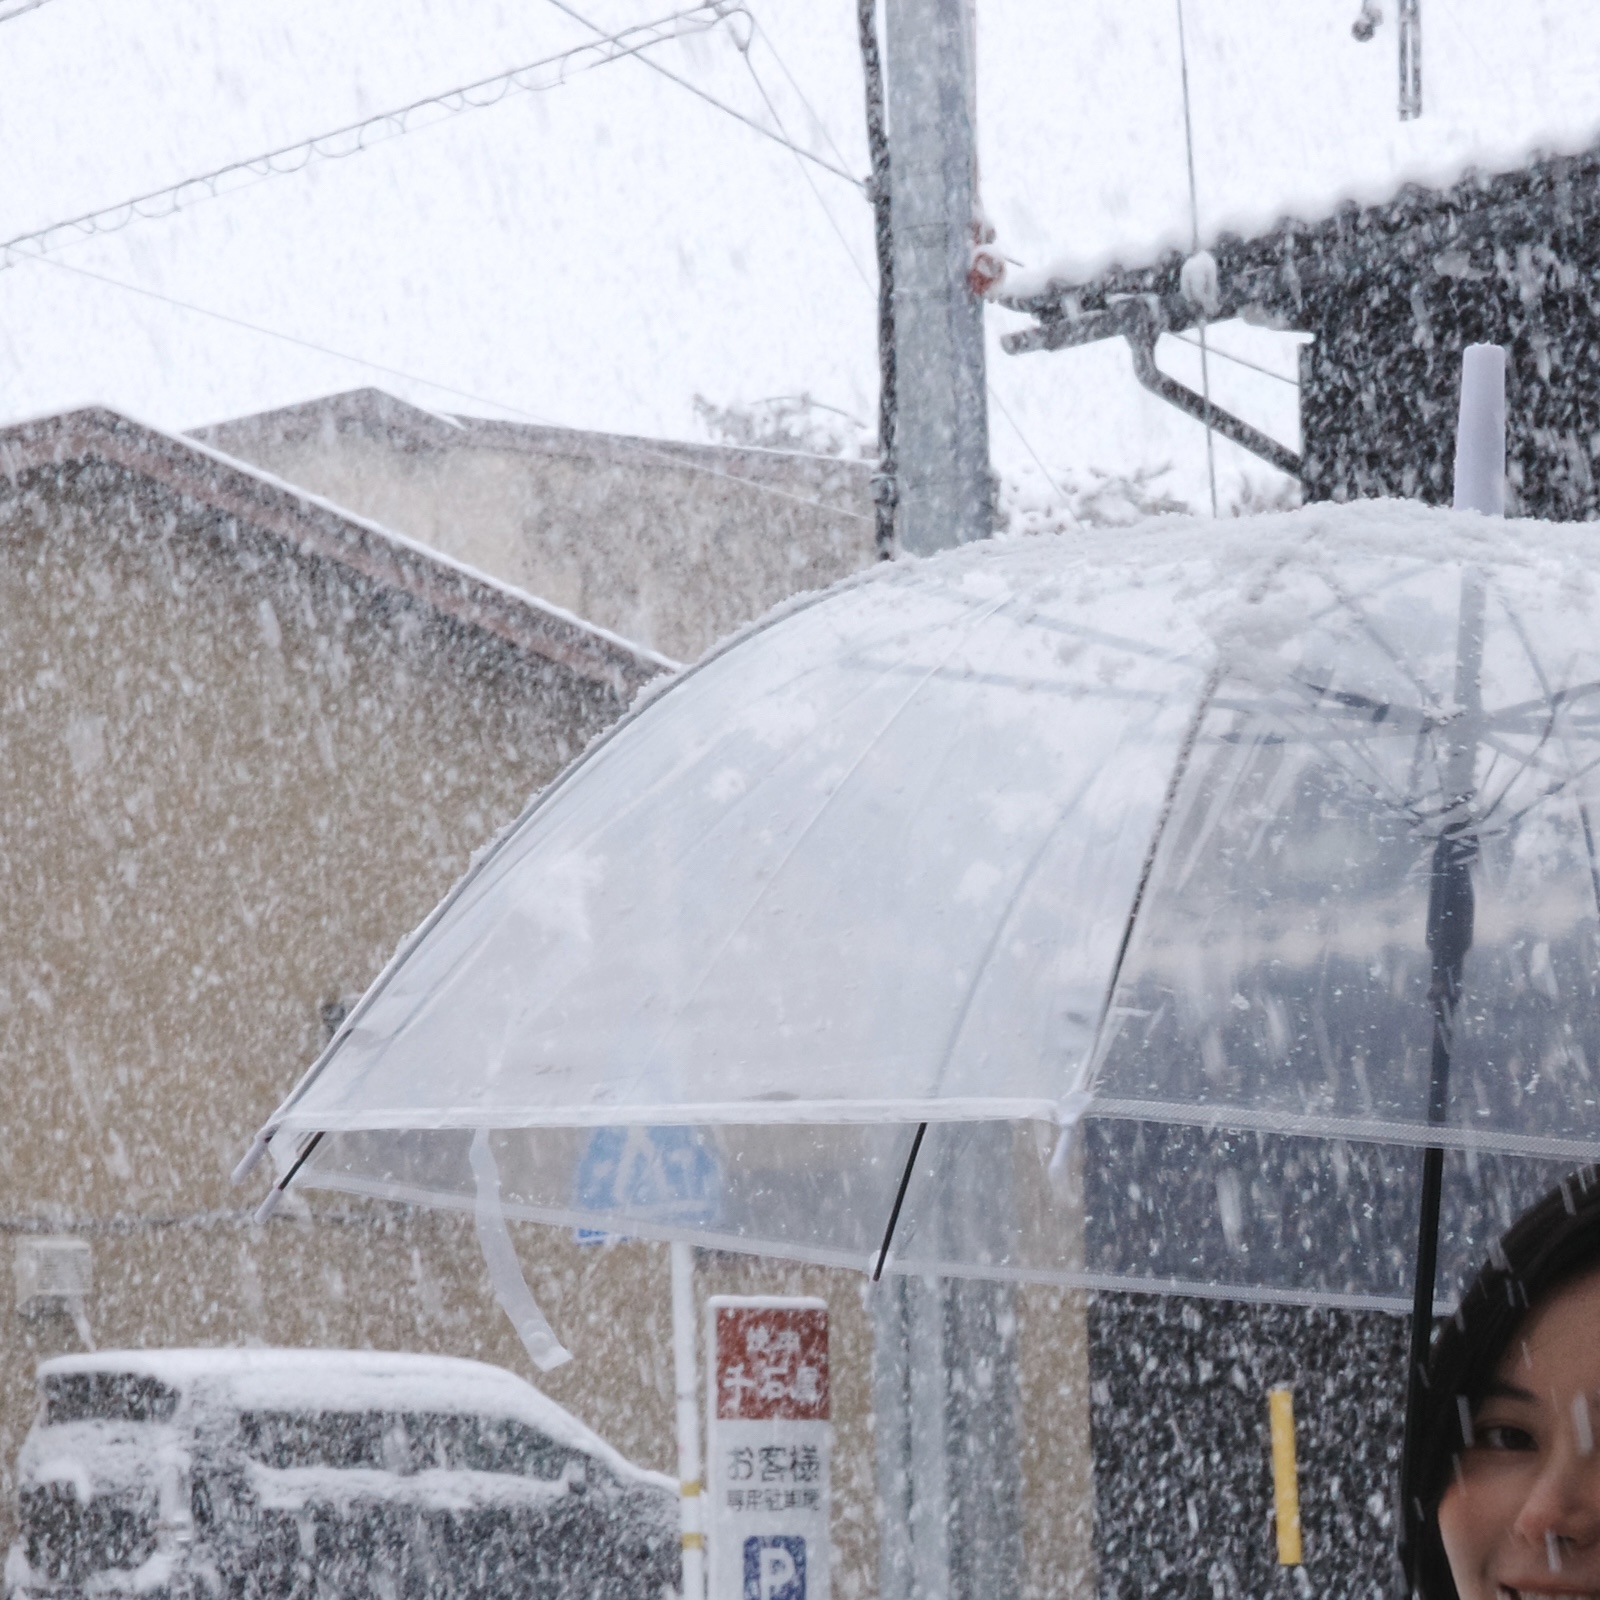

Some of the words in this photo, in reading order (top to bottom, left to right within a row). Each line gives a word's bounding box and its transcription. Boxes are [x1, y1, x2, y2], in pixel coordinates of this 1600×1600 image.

[727, 1445, 819, 1482] お客様
[727, 1489, 820, 1511] 専用駐車場
